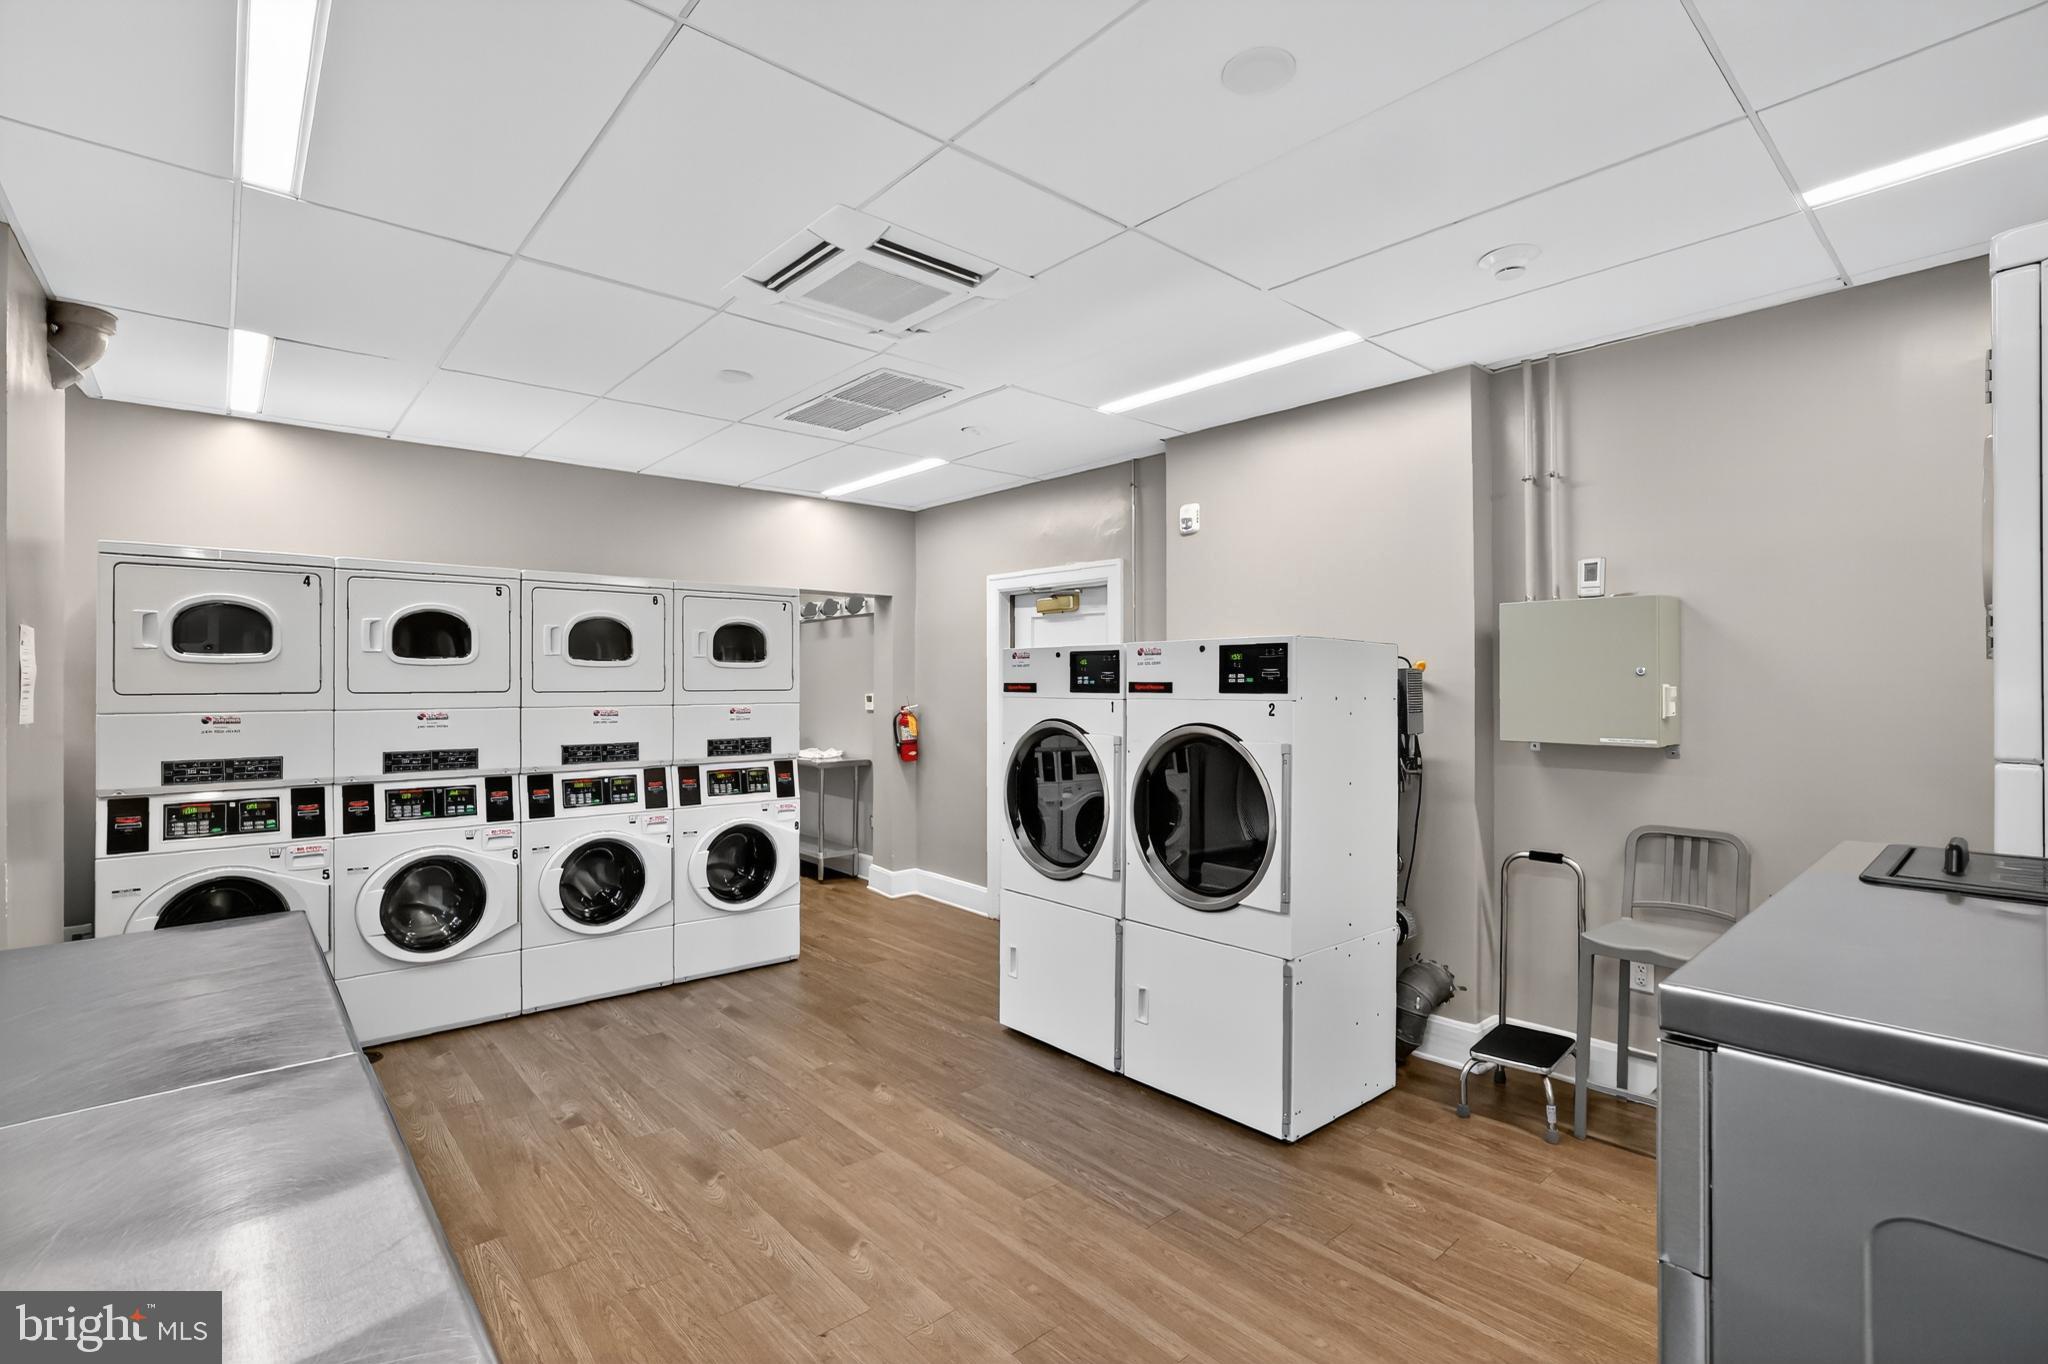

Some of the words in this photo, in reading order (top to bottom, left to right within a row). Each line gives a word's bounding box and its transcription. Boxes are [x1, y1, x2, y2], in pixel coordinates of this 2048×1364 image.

[303, 575, 311, 587] 4
[495, 586, 502, 597] 5
[781, 602, 787, 612] 7
[1268, 702, 1276, 717] 2
[666, 834, 672, 844] 7
[512, 848, 519, 860] 6
[321, 868, 331, 880] 5
